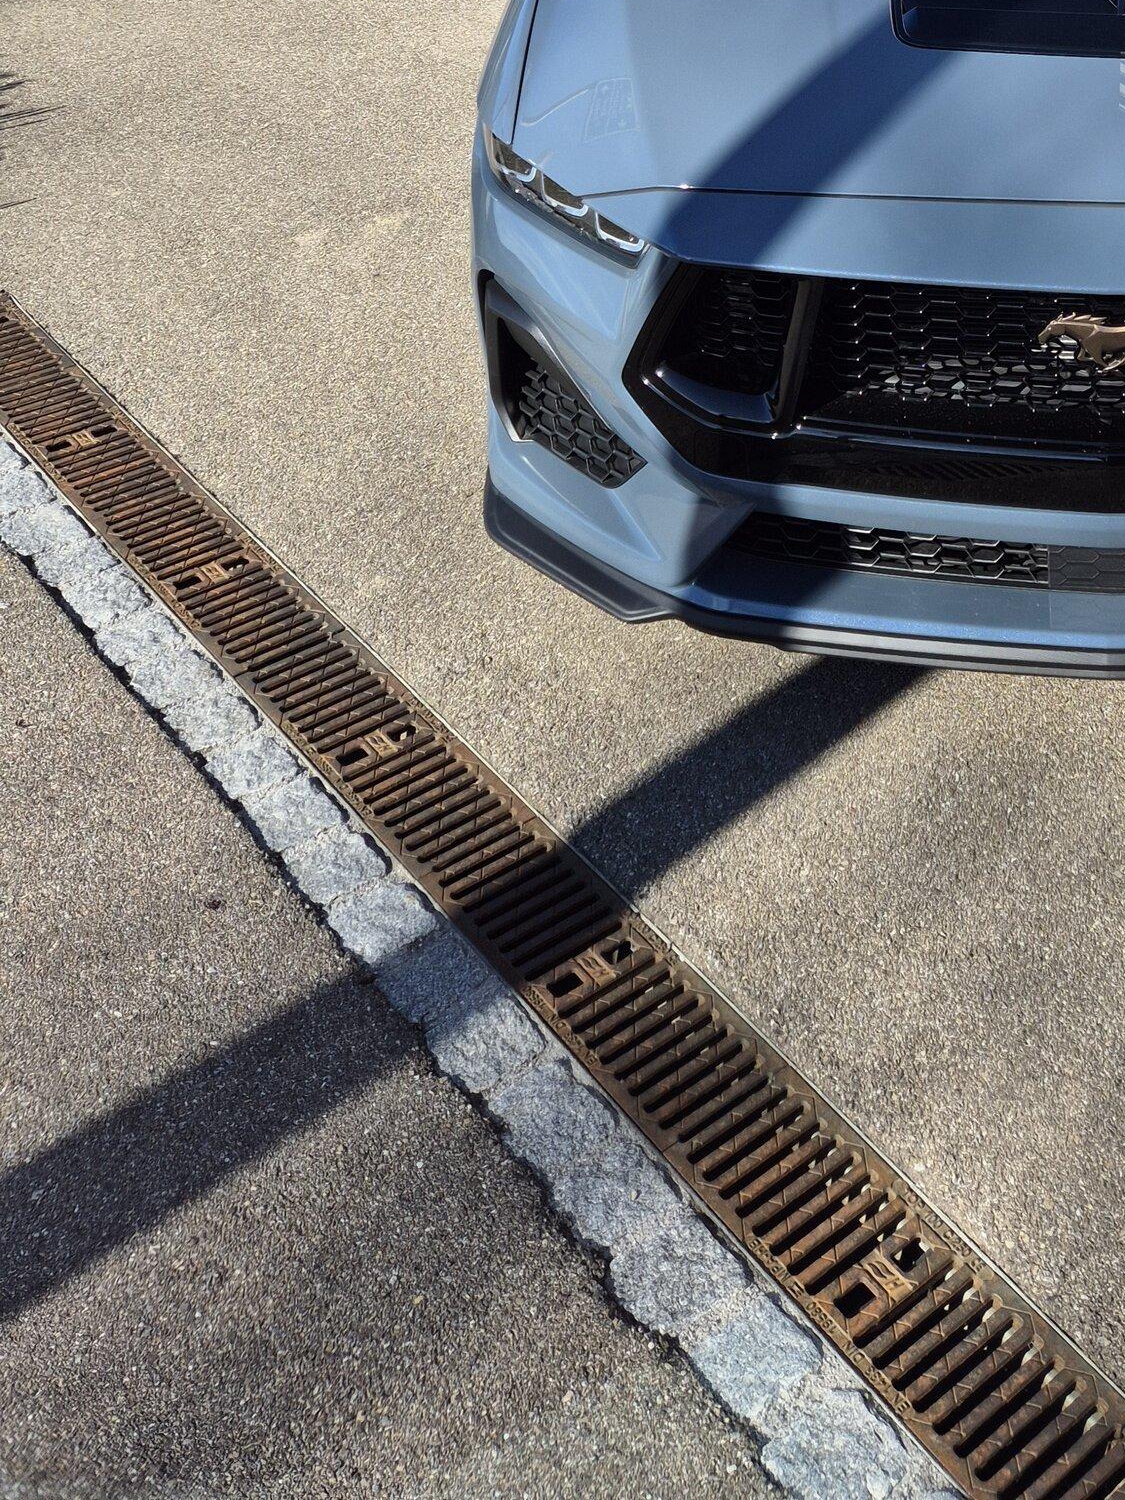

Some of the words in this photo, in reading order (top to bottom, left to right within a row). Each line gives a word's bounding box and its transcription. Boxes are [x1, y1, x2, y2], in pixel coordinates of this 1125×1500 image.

[806, 1301, 838, 1335] 19580
[842, 1340, 864, 1364] DIN
[864, 1365, 892, 1394] 1433
[891, 1393, 910, 1413] EN
